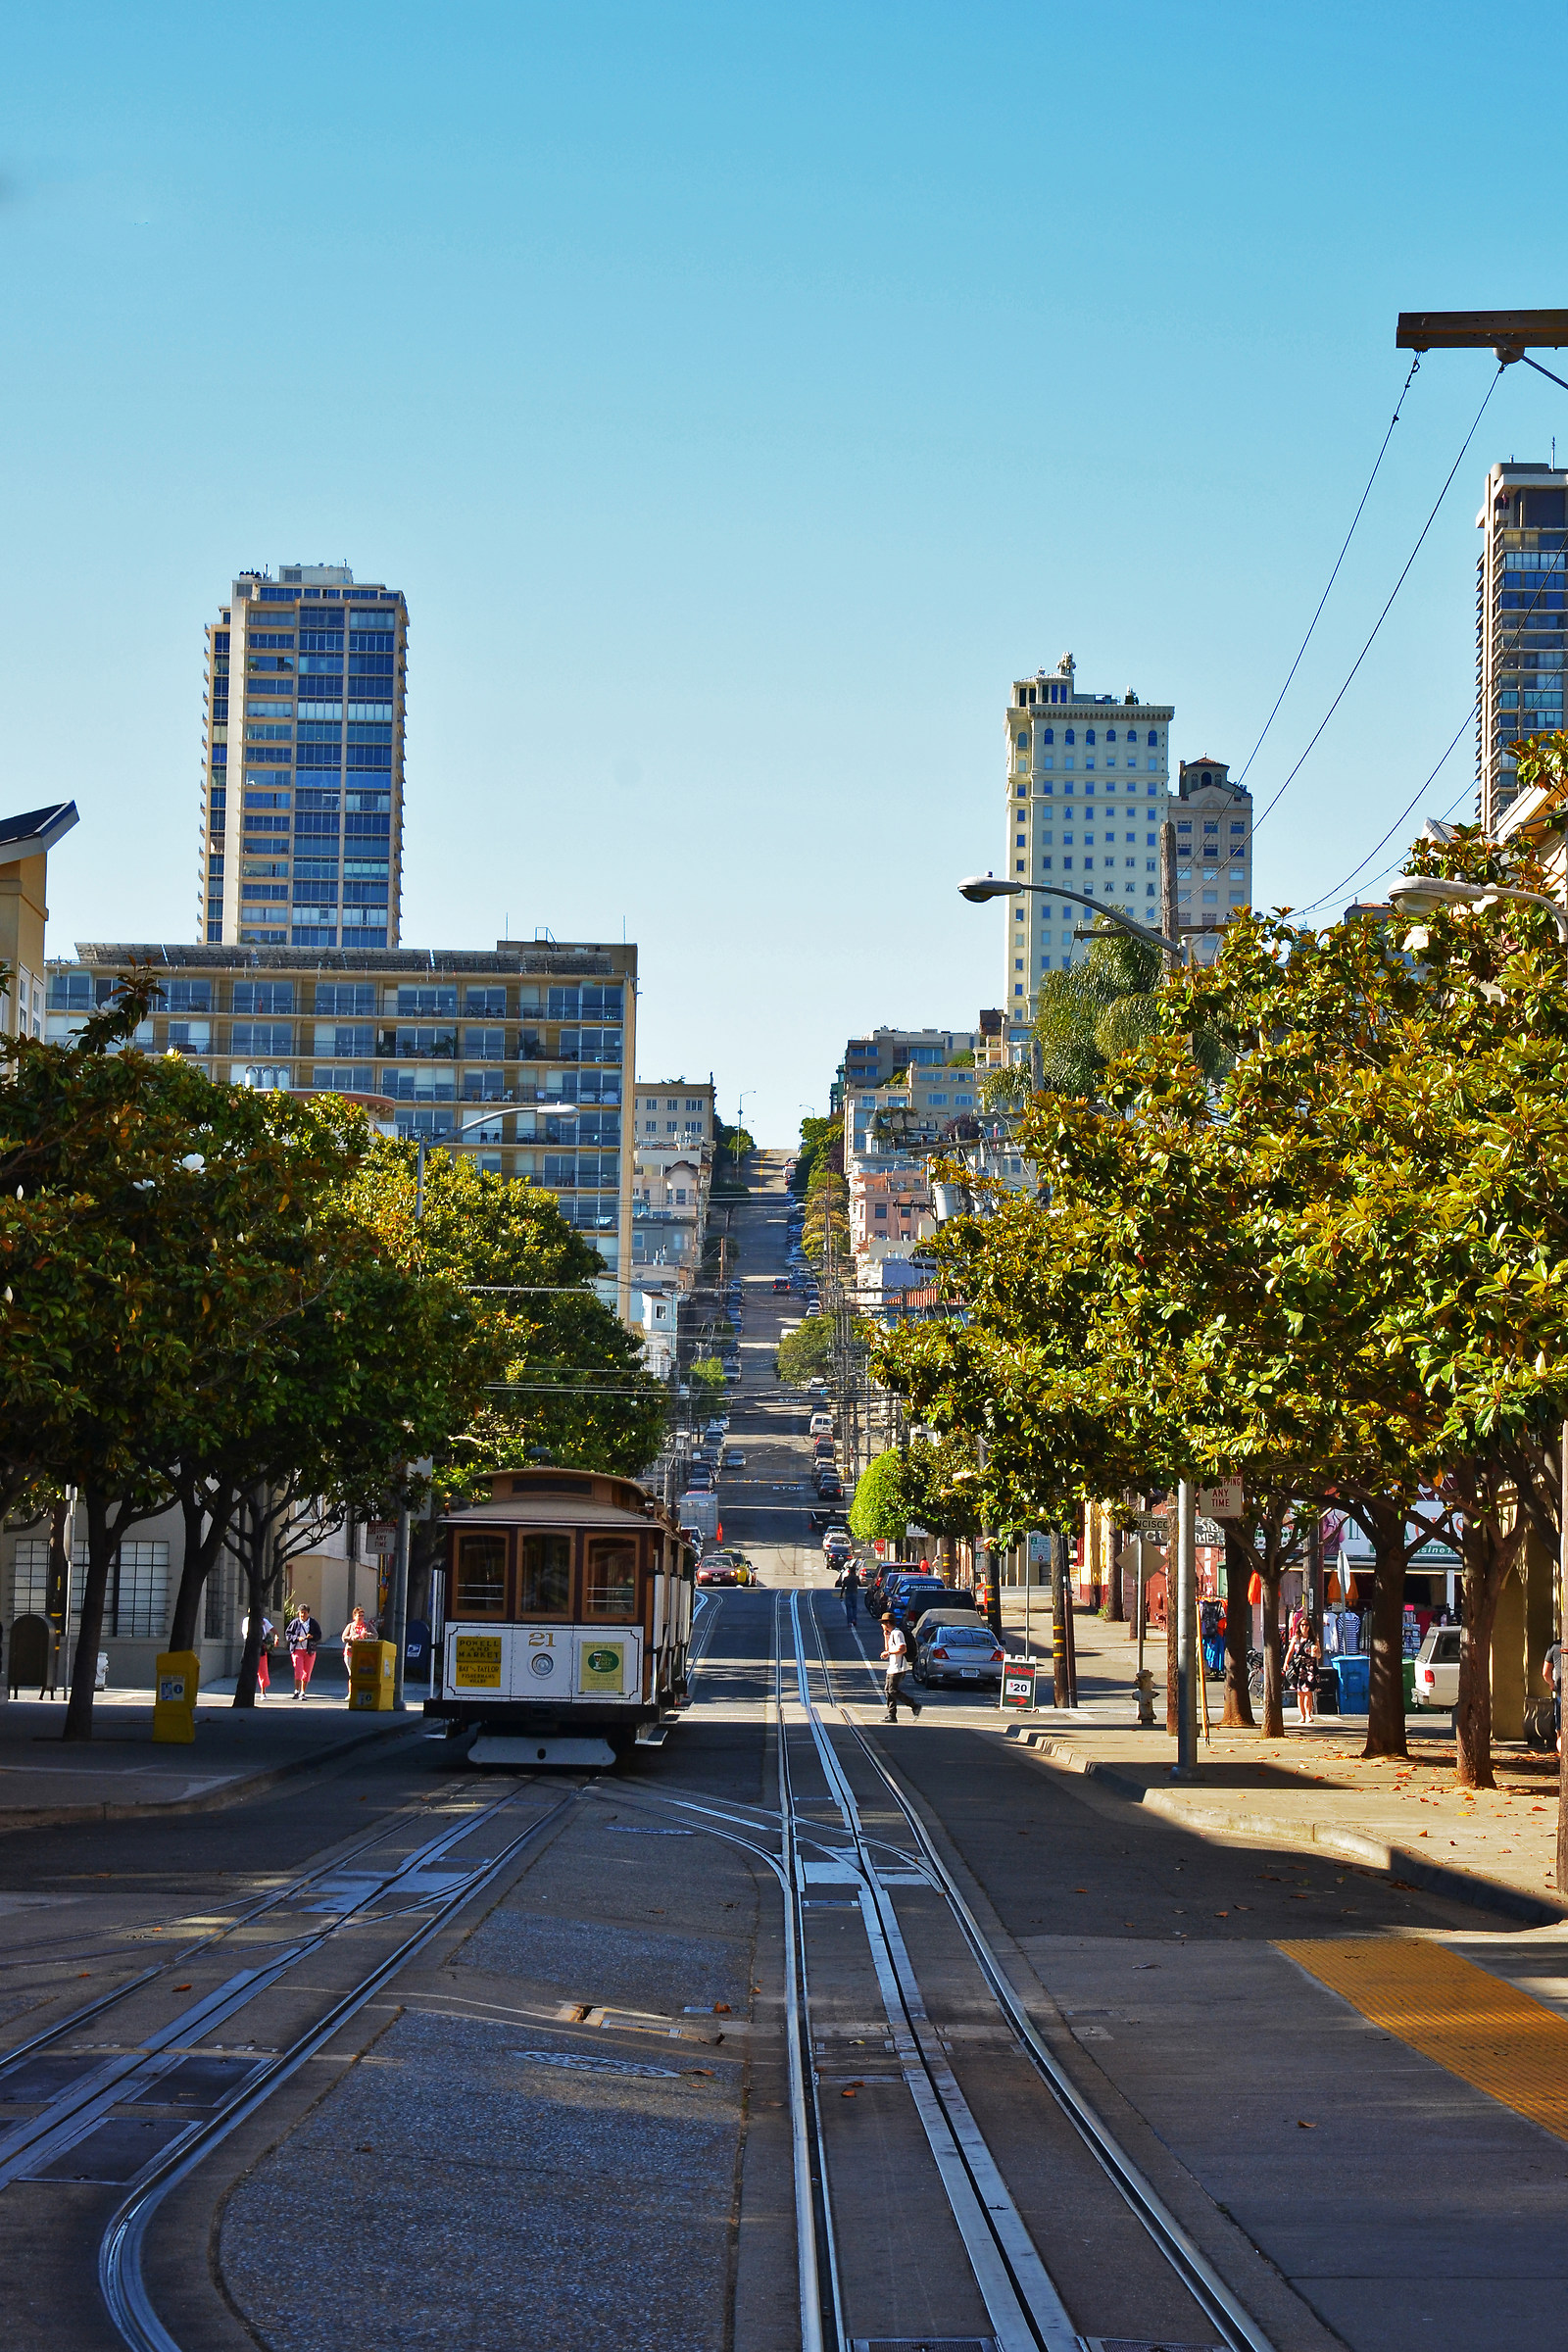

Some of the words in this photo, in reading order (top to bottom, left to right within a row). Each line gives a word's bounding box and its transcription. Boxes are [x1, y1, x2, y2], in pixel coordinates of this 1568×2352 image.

[1211, 1498, 1230, 1507] TIME
[528, 1632, 557, 1647] 21
[1010, 1682, 1028, 1692] $20
